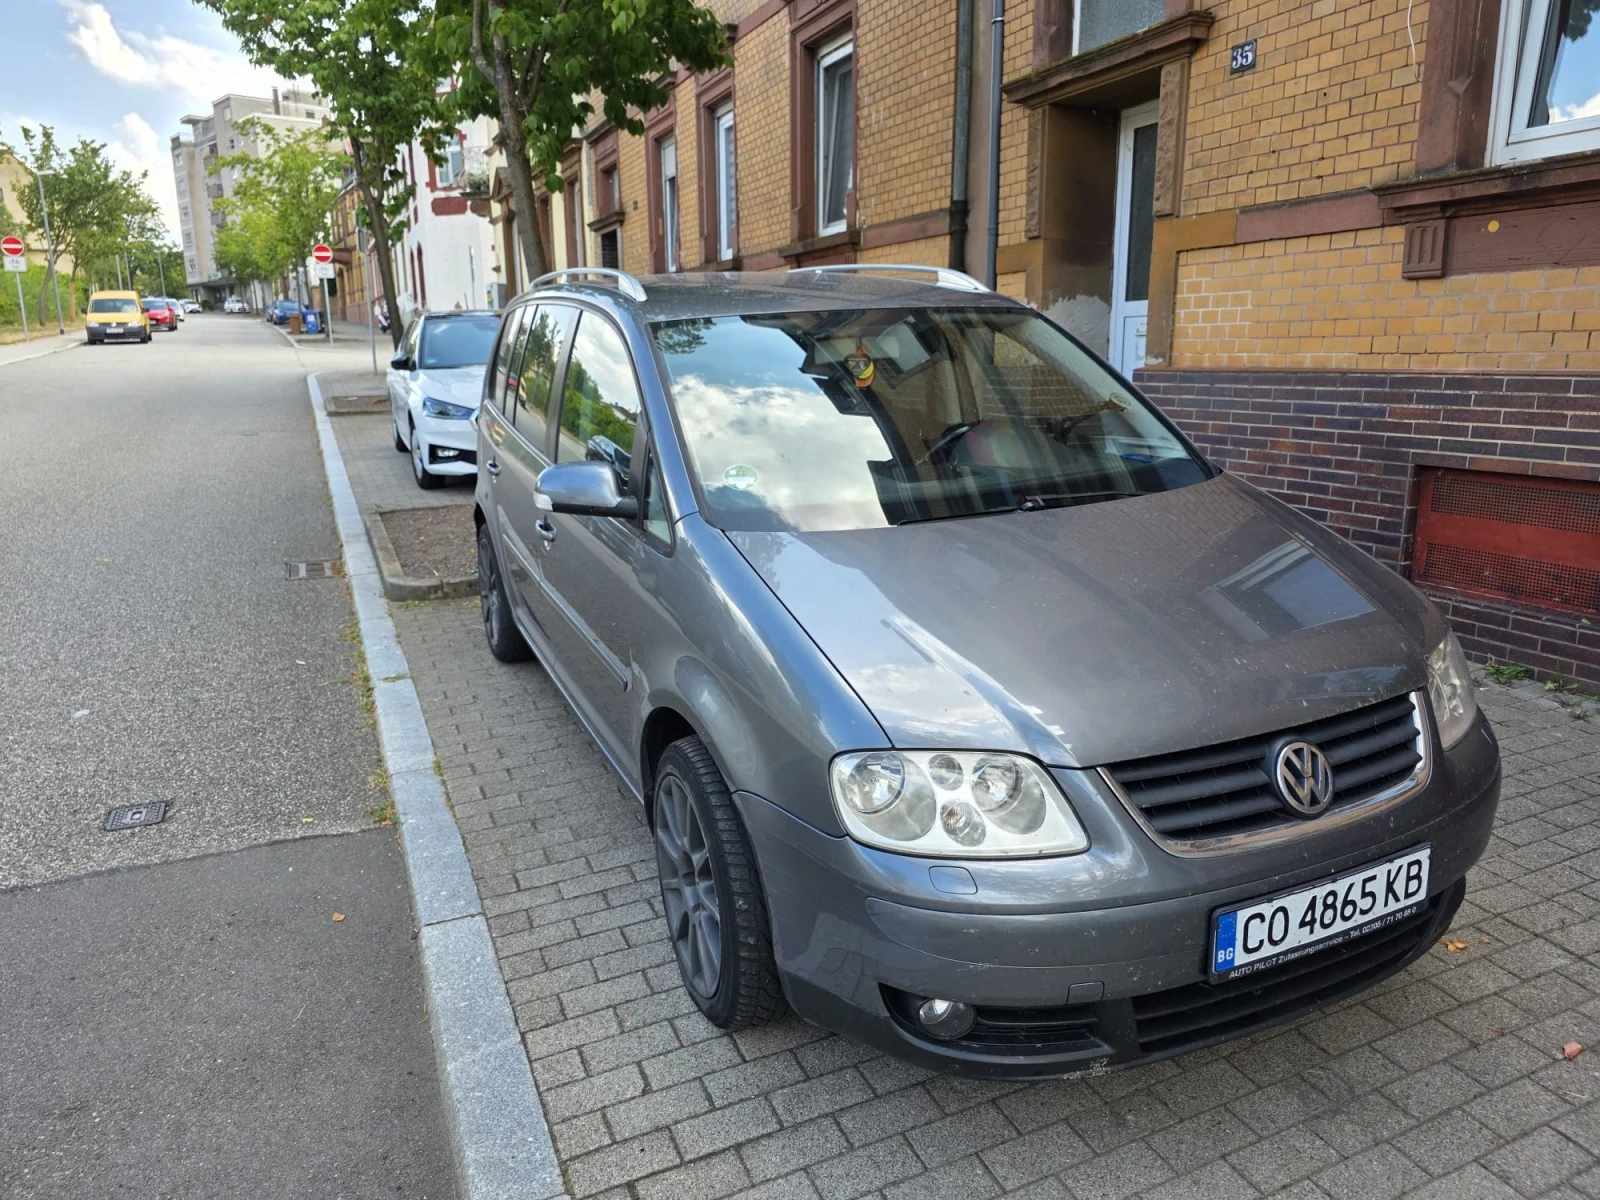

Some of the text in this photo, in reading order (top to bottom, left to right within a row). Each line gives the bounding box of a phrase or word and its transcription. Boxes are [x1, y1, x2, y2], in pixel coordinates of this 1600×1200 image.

[1232, 44, 1253, 69] 35
[1279, 743, 1329, 810] VW
[1242, 859, 1423, 955] CO 4865 KB
[1217, 947, 1234, 963] BG
[1229, 965, 1252, 979] AUTO
[1253, 957, 1278, 972] PILOT
[1278, 936, 1343, 963] Zulassungsservice
